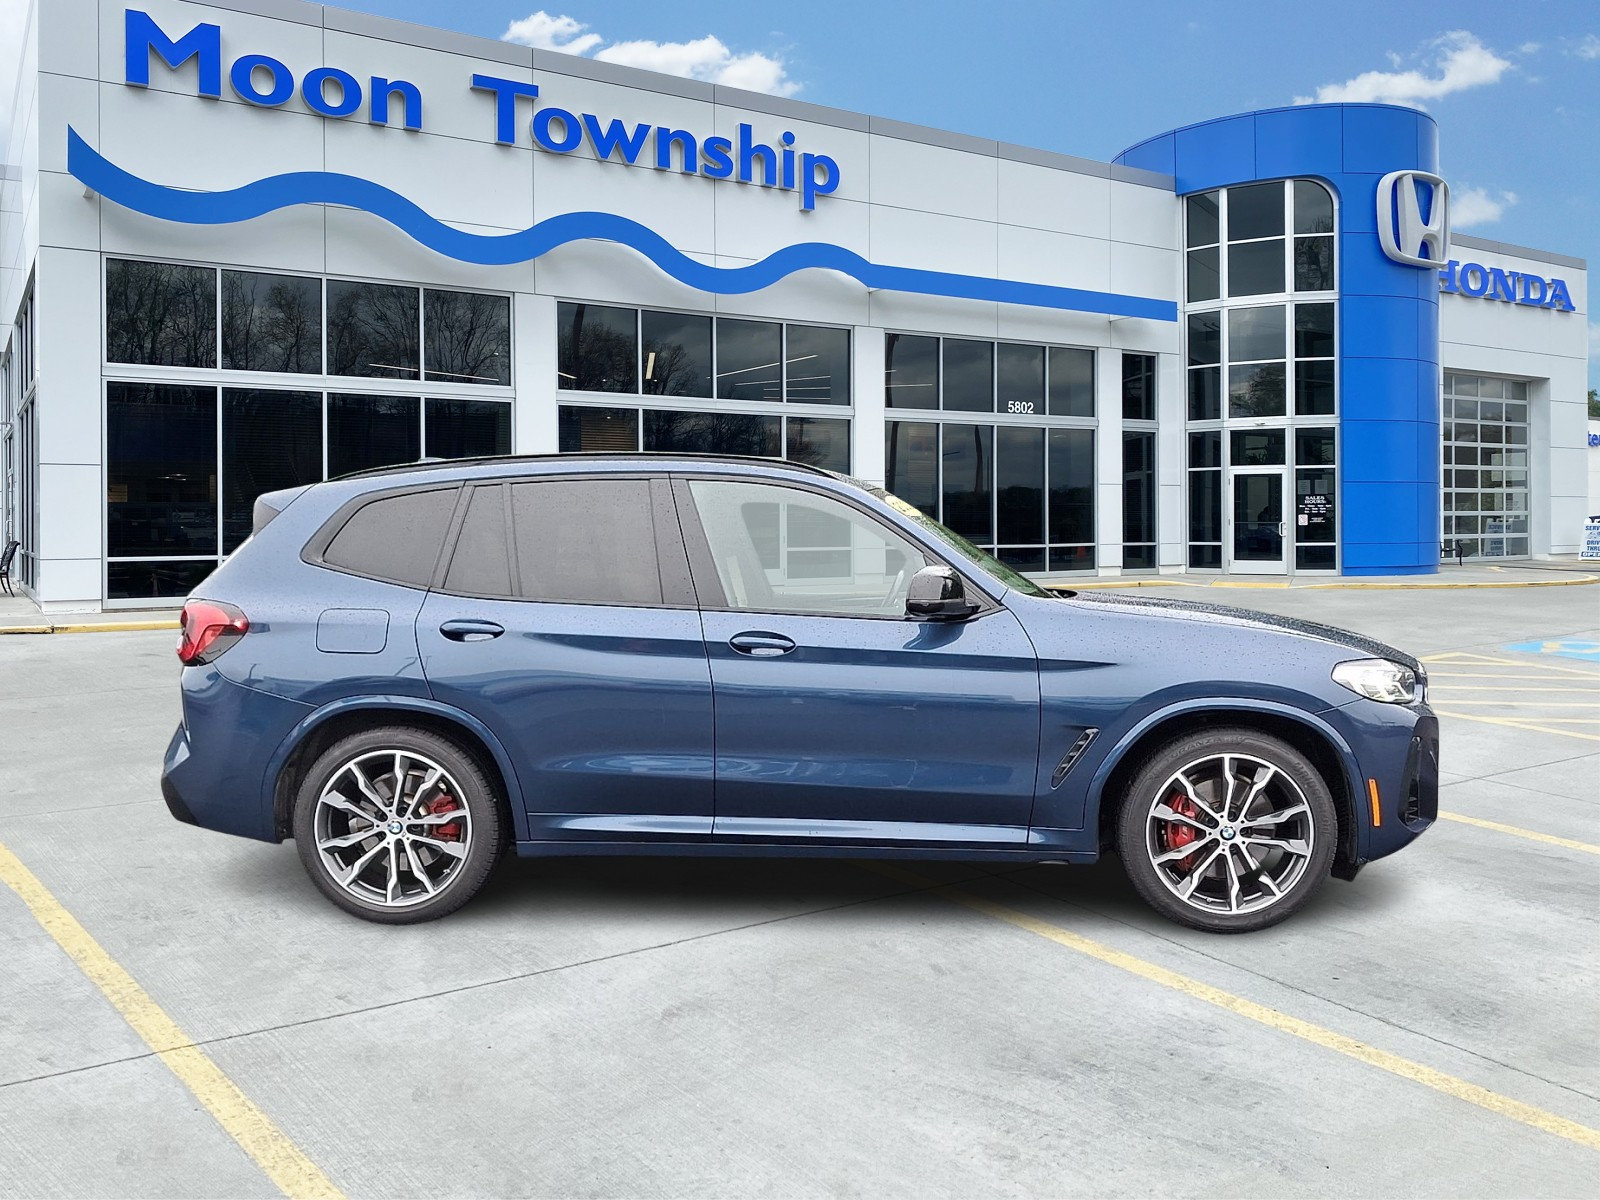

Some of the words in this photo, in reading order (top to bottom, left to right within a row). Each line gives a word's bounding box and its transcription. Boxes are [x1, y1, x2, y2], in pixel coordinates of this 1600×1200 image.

[125, 8, 422, 131] Moon
[469, 73, 840, 212] Township
[1439, 259, 1576, 311] HONDA
[1007, 400, 1034, 414] 5802
